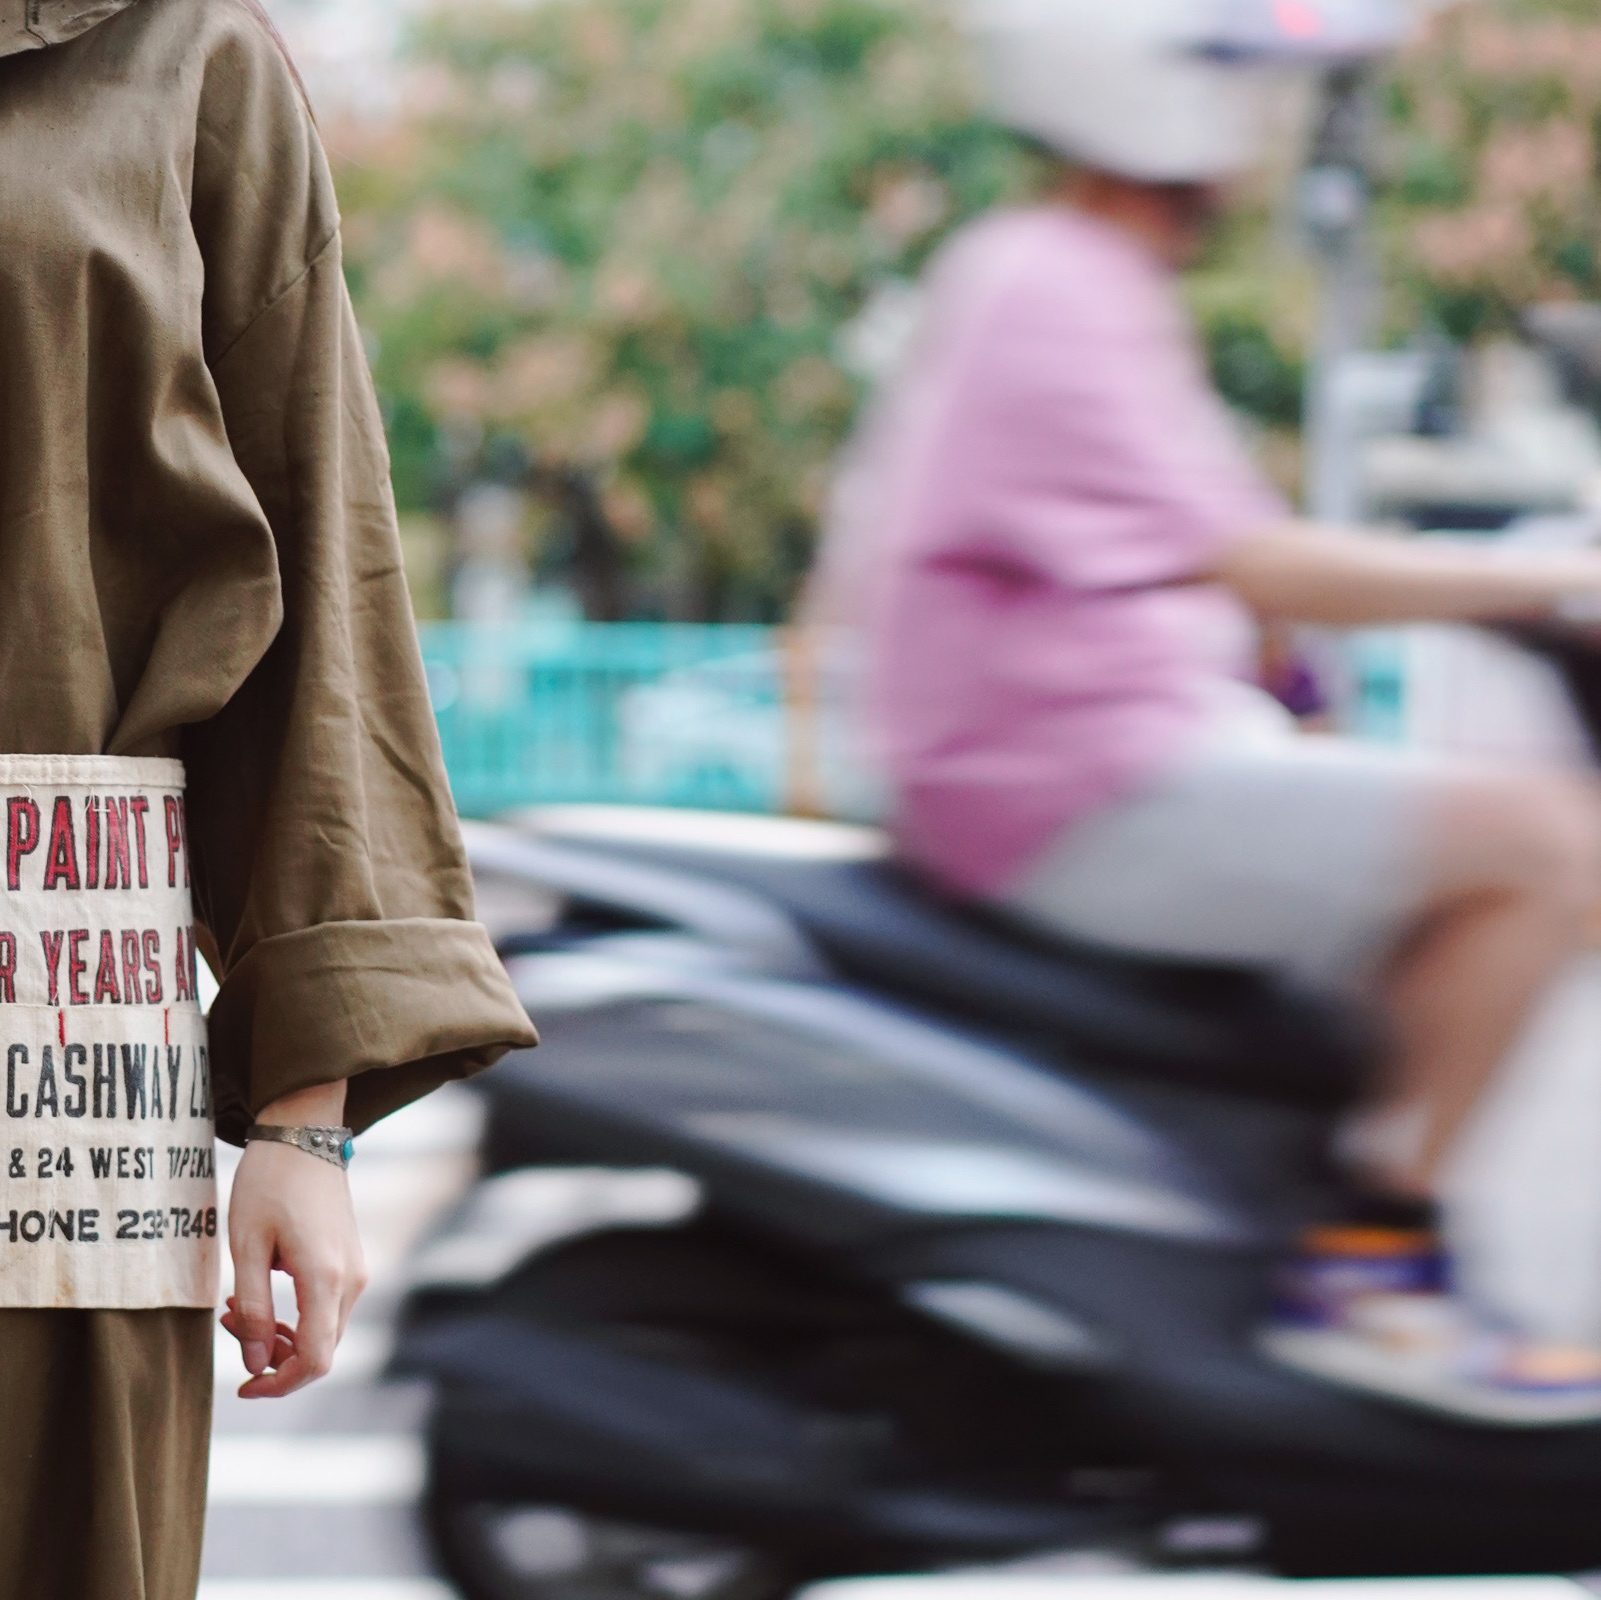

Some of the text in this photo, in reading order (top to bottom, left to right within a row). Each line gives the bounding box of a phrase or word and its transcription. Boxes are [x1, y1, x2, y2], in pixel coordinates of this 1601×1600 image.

[6, 795, 150, 890] PAINT
[163, 795, 191, 888] P
[39, 928, 163, 1006] YEARS
[6, 1043, 181, 1121] CASHWAY
[8, 1147, 26, 1179] &
[37, 1147, 74, 1179] 24
[89, 1146, 154, 1180] WEST
